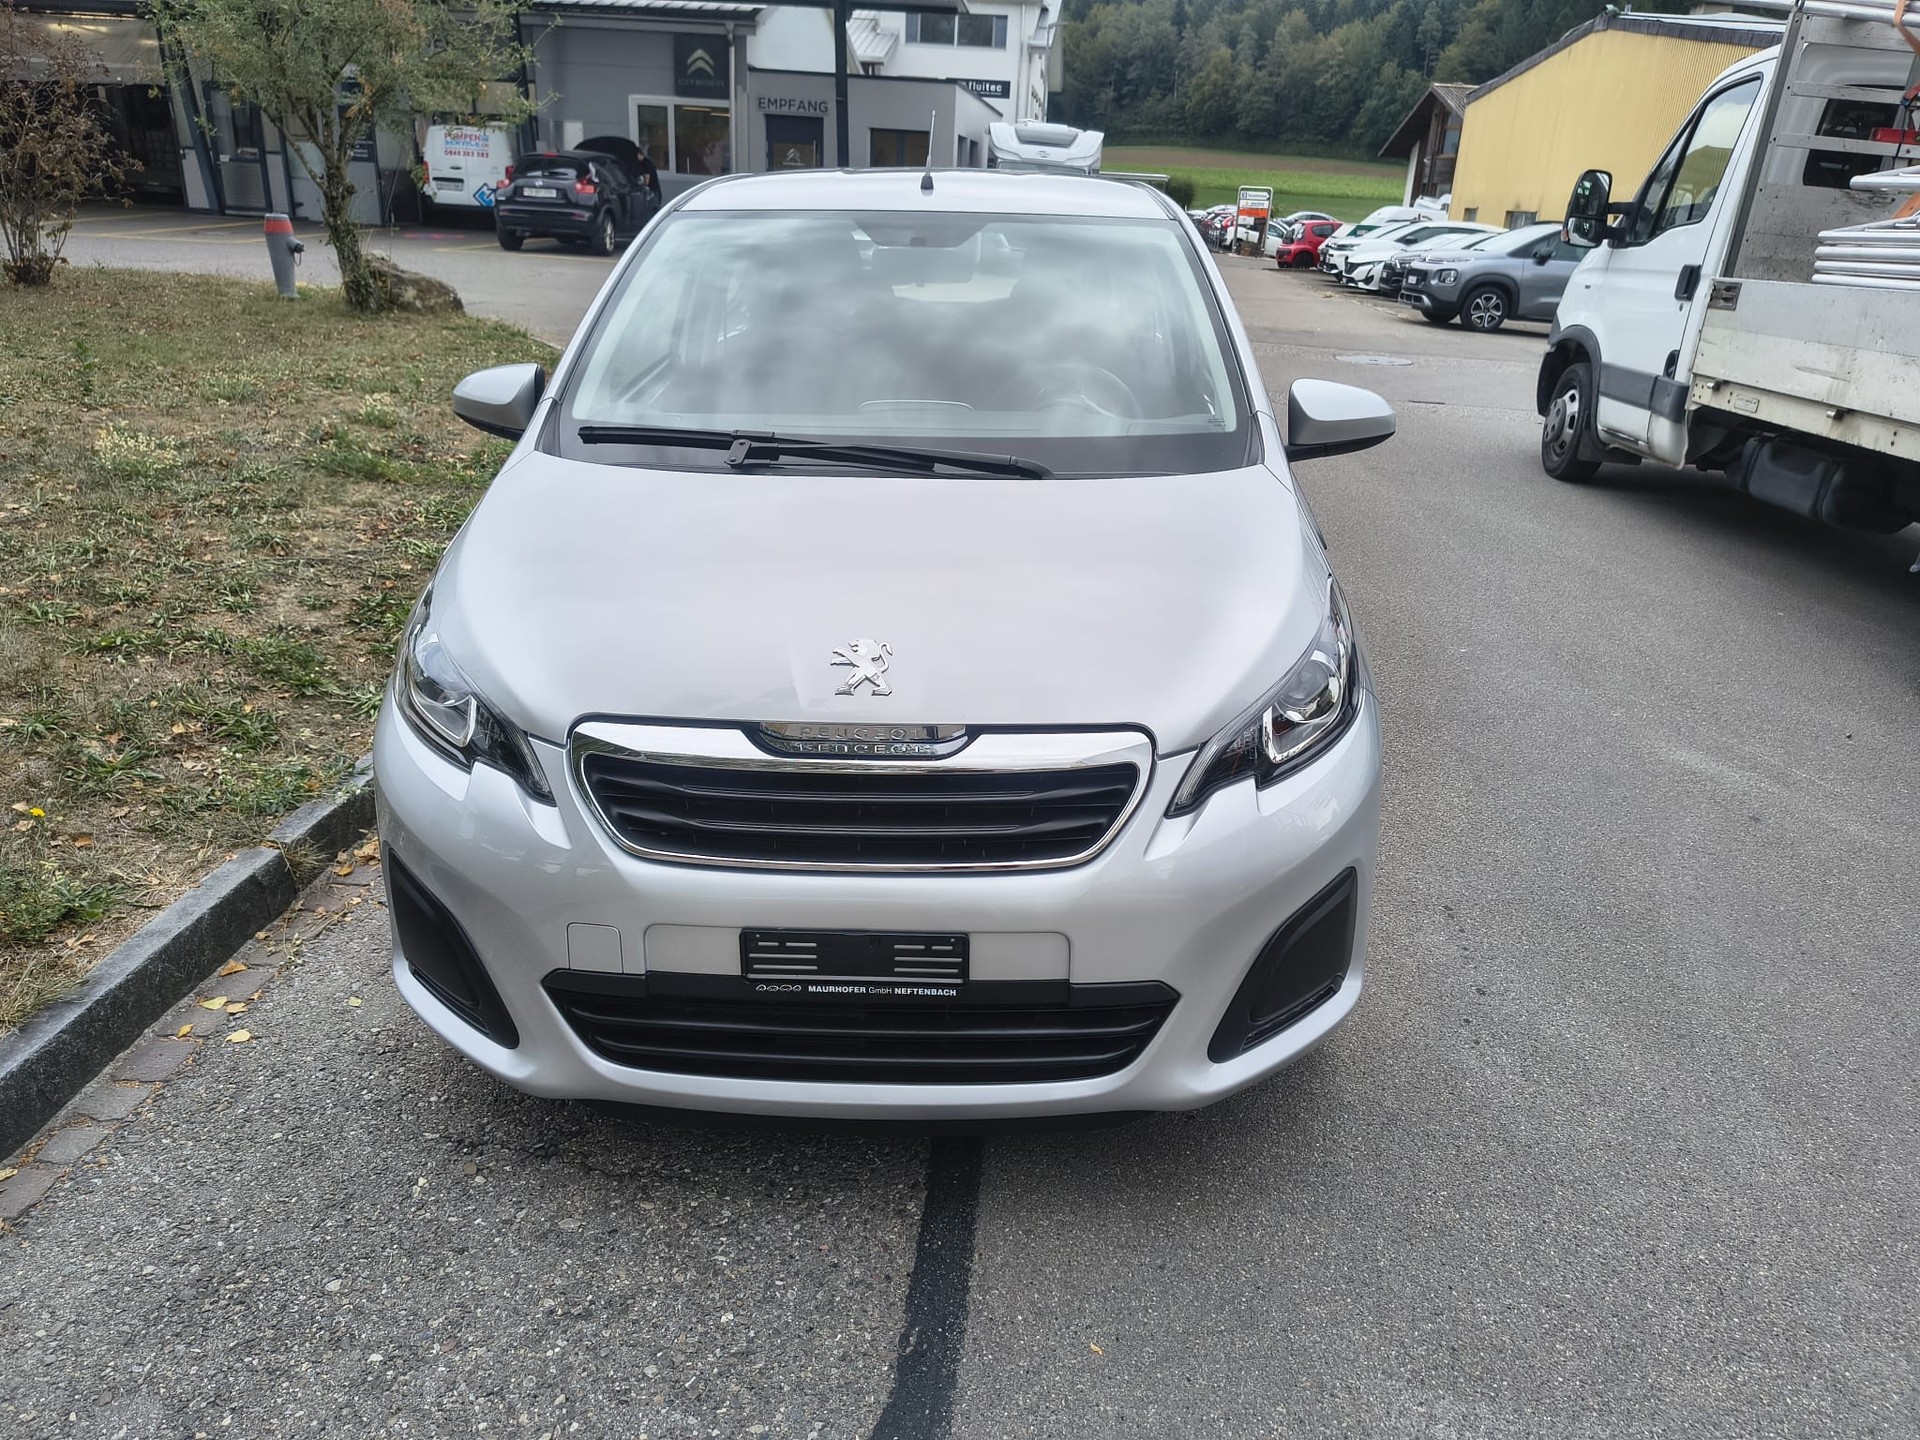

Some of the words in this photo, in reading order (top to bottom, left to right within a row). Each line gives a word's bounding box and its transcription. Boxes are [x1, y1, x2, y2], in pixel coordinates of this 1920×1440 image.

[758, 97, 829, 113] EMPFANG
[808, 985, 866, 994] MAURHOFER
[868, 986, 892, 995] GmbH
[894, 987, 957, 996] NEFTENBACH
